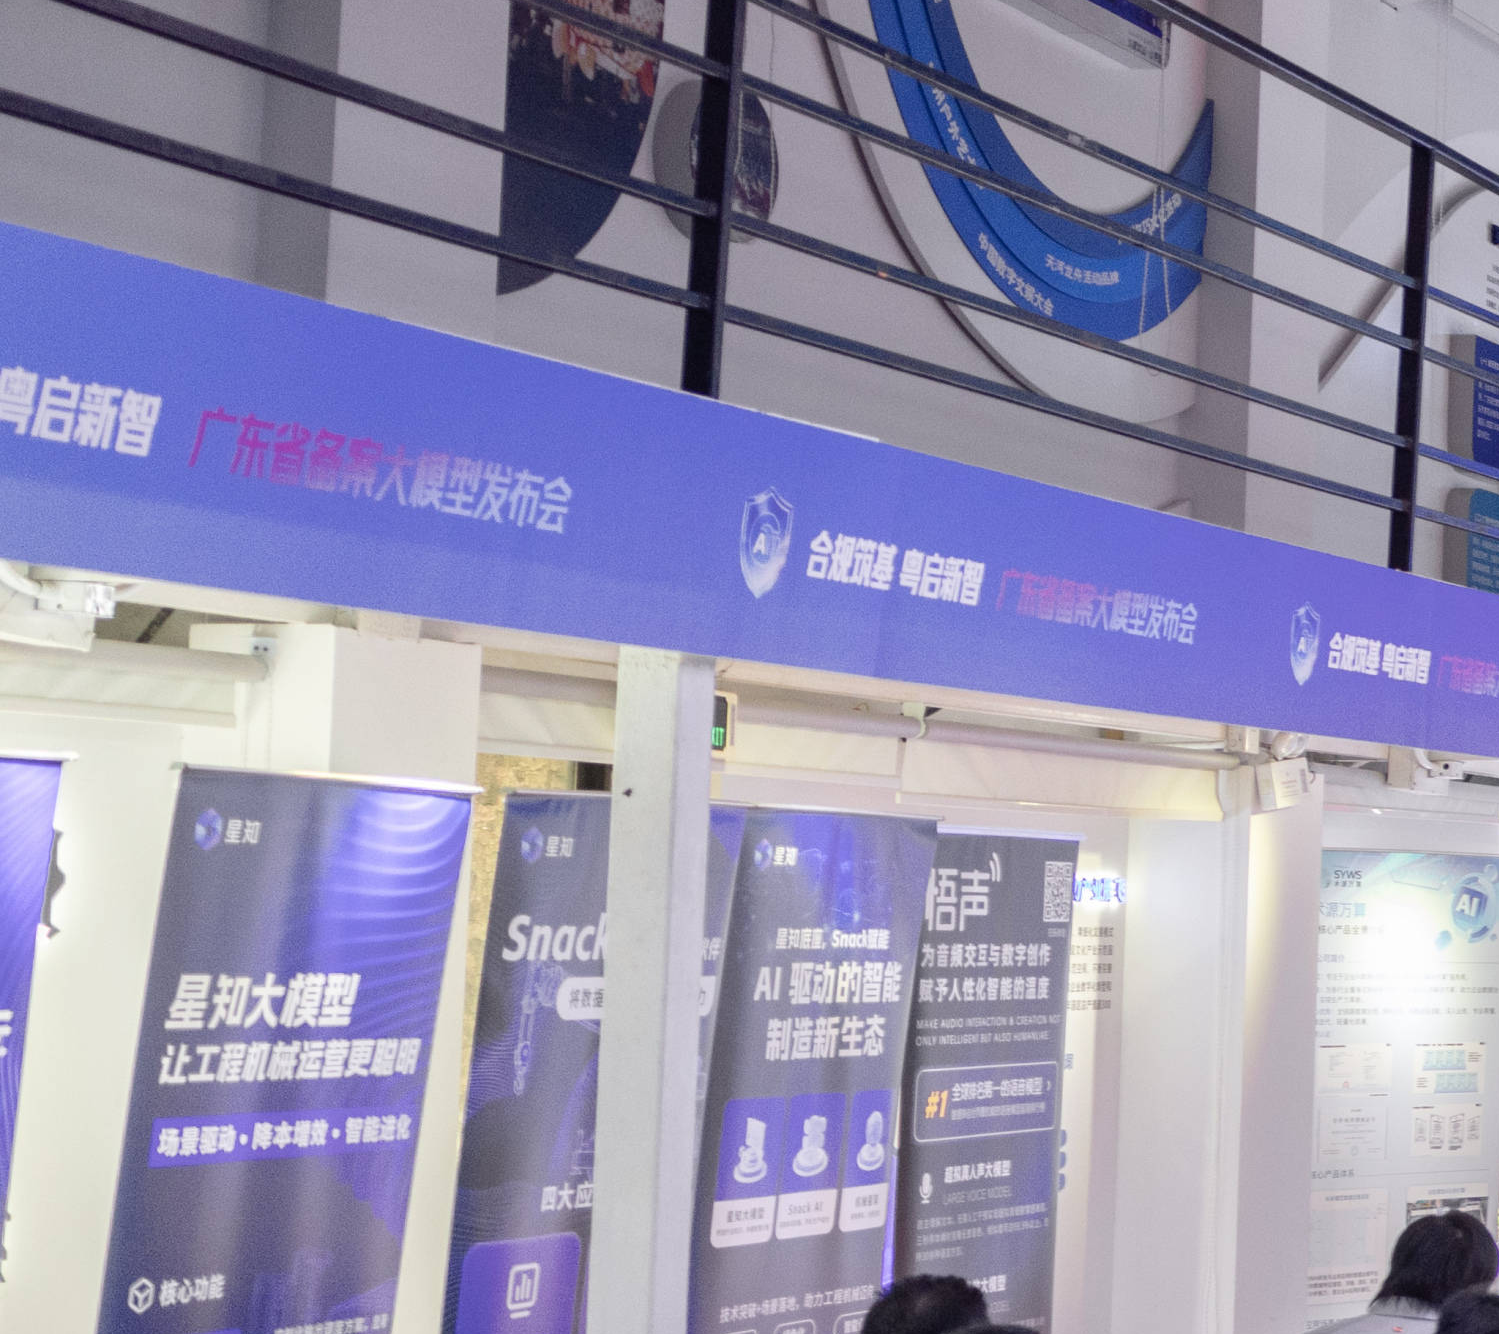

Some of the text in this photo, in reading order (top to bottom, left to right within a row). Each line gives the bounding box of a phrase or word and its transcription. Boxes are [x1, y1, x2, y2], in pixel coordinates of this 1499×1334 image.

[0, 365, 573, 535] 粤启新智 广东省备案大模型发布会
[806, 529, 1198, 646] 合规筑基 粤启新智 广东省备案大模型发布会
[224, 818, 261, 845] 星知
[545, 835, 574, 858] 星知
[1333, 869, 1363, 880] SYWS
[1455, 893, 1481, 917] AI
[920, 942, 1052, 969] 为音频交互与数字创作
[753, 960, 903, 1006] AI 驱动的智能
[917, 976, 1051, 1004] 赋予人性化智能的温度
[163, 971, 361, 1031] 星知大模型
[940, 1018, 964, 1028] AUDIO
[764, 1013, 886, 1062] 制造新生态
[915, 1035, 937, 1047] ONLY
[924, 1090, 949, 1119] #1
